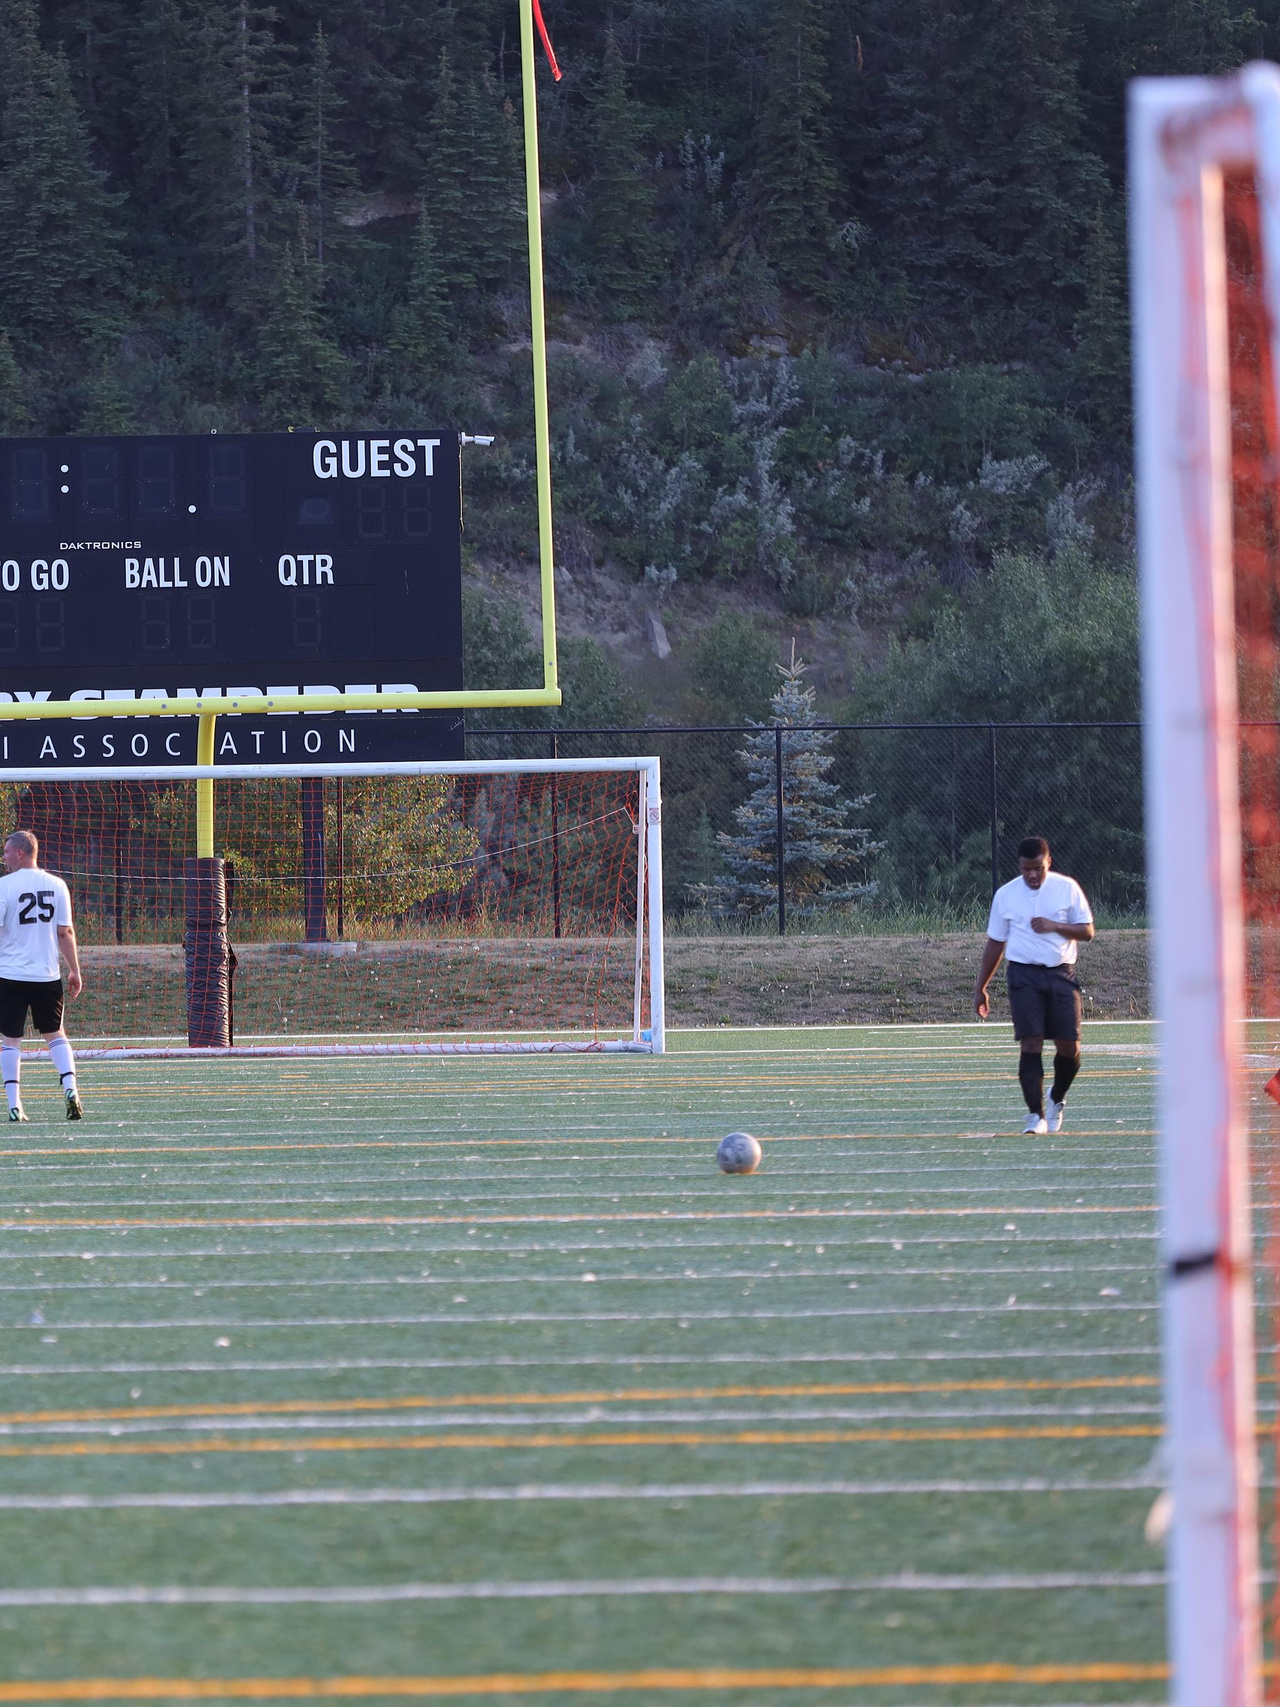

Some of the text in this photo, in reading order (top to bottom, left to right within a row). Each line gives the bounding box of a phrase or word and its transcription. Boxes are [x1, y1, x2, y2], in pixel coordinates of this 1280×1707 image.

[312, 438, 441, 479] GUEST
[59, 541, 142, 550] DAKTRONICS
[30, 558, 70, 591] GO
[125, 555, 231, 589] BALL ON
[278, 554, 335, 586] QTR
[39, 729, 356, 759] ASSOCATION
[18, 890, 55, 925] 25
